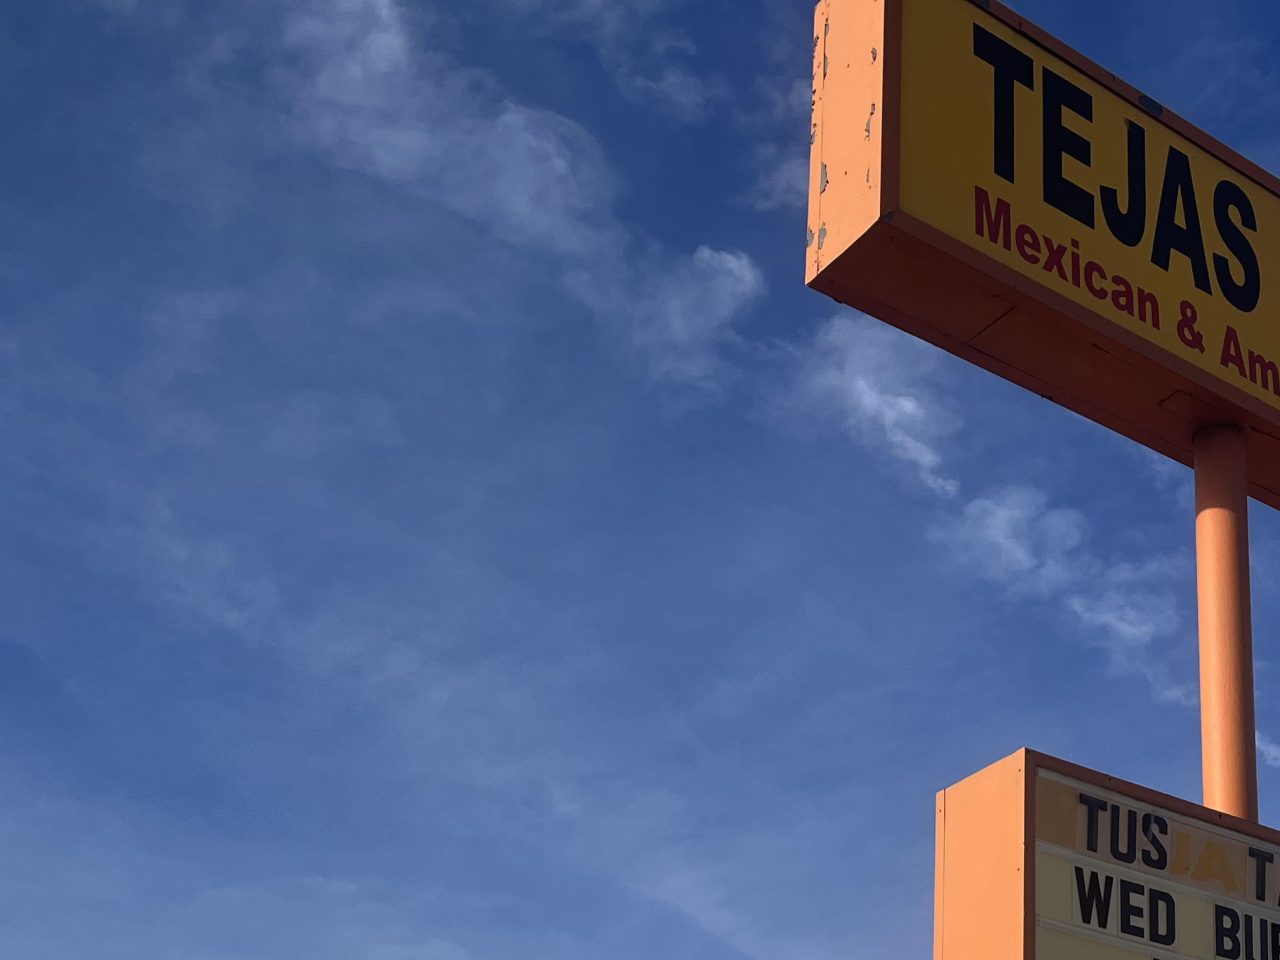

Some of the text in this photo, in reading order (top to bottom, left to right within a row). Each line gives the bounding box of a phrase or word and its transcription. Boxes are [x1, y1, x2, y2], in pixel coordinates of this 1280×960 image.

[972, 22, 1261, 314] TEJAS
[973, 186, 1161, 331] Mexican
[1177, 300, 1206, 355] &
[1079, 792, 1168, 871] TUS
[1074, 865, 1176, 946] WED
